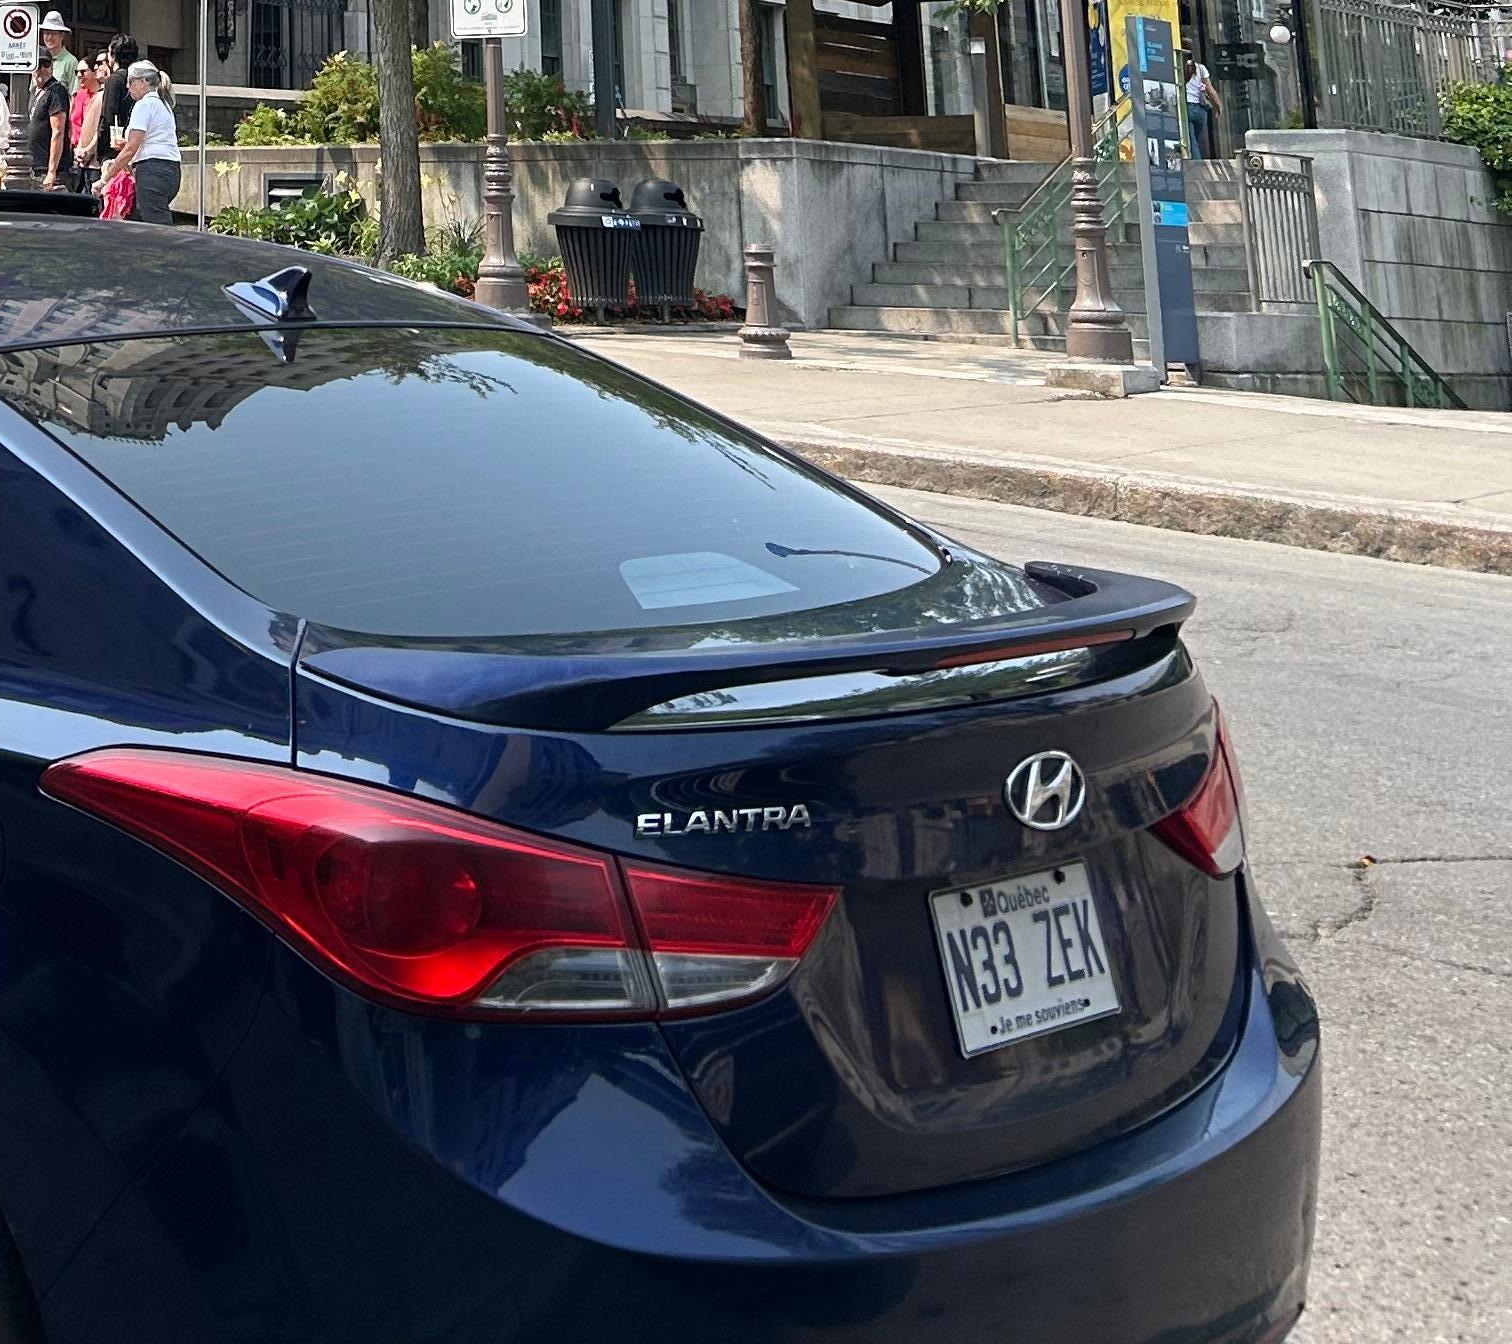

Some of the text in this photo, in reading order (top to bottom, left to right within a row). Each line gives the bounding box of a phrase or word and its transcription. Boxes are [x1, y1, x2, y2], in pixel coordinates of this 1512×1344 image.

[636, 803, 812, 838] ELANTRA
[997, 884, 1051, 914] Québec
[946, 898, 1106, 1013] N33 ZEK
[999, 997, 1086, 1034] Je me souviens
